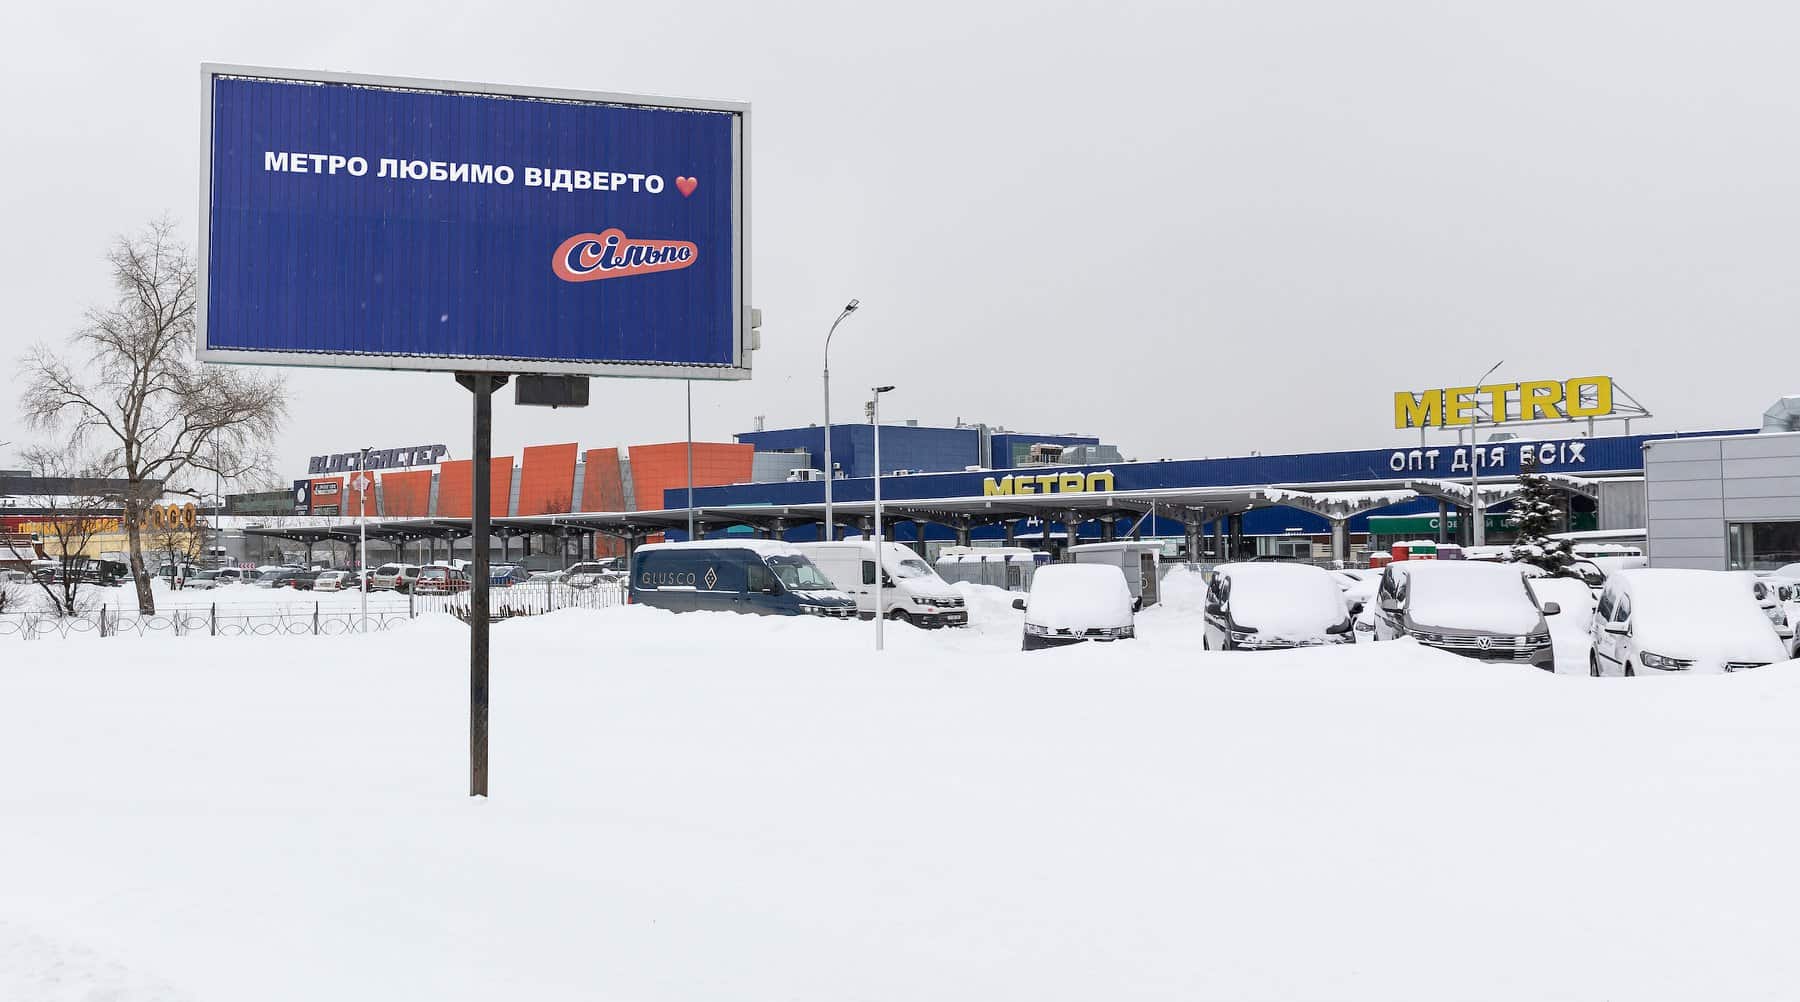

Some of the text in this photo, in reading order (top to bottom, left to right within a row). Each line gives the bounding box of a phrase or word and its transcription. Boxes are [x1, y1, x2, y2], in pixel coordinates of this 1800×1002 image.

[264, 151, 665, 194] МЕТРО ЛЮБИМО ВІДВЕРТО
[565, 236, 693, 274] Сільпо
[1394, 376, 1613, 429] METRO
[1390, 442, 1587, 472] ОПТ ДЛЯ ВСІХ
[642, 571, 696, 585] GLUSCO
